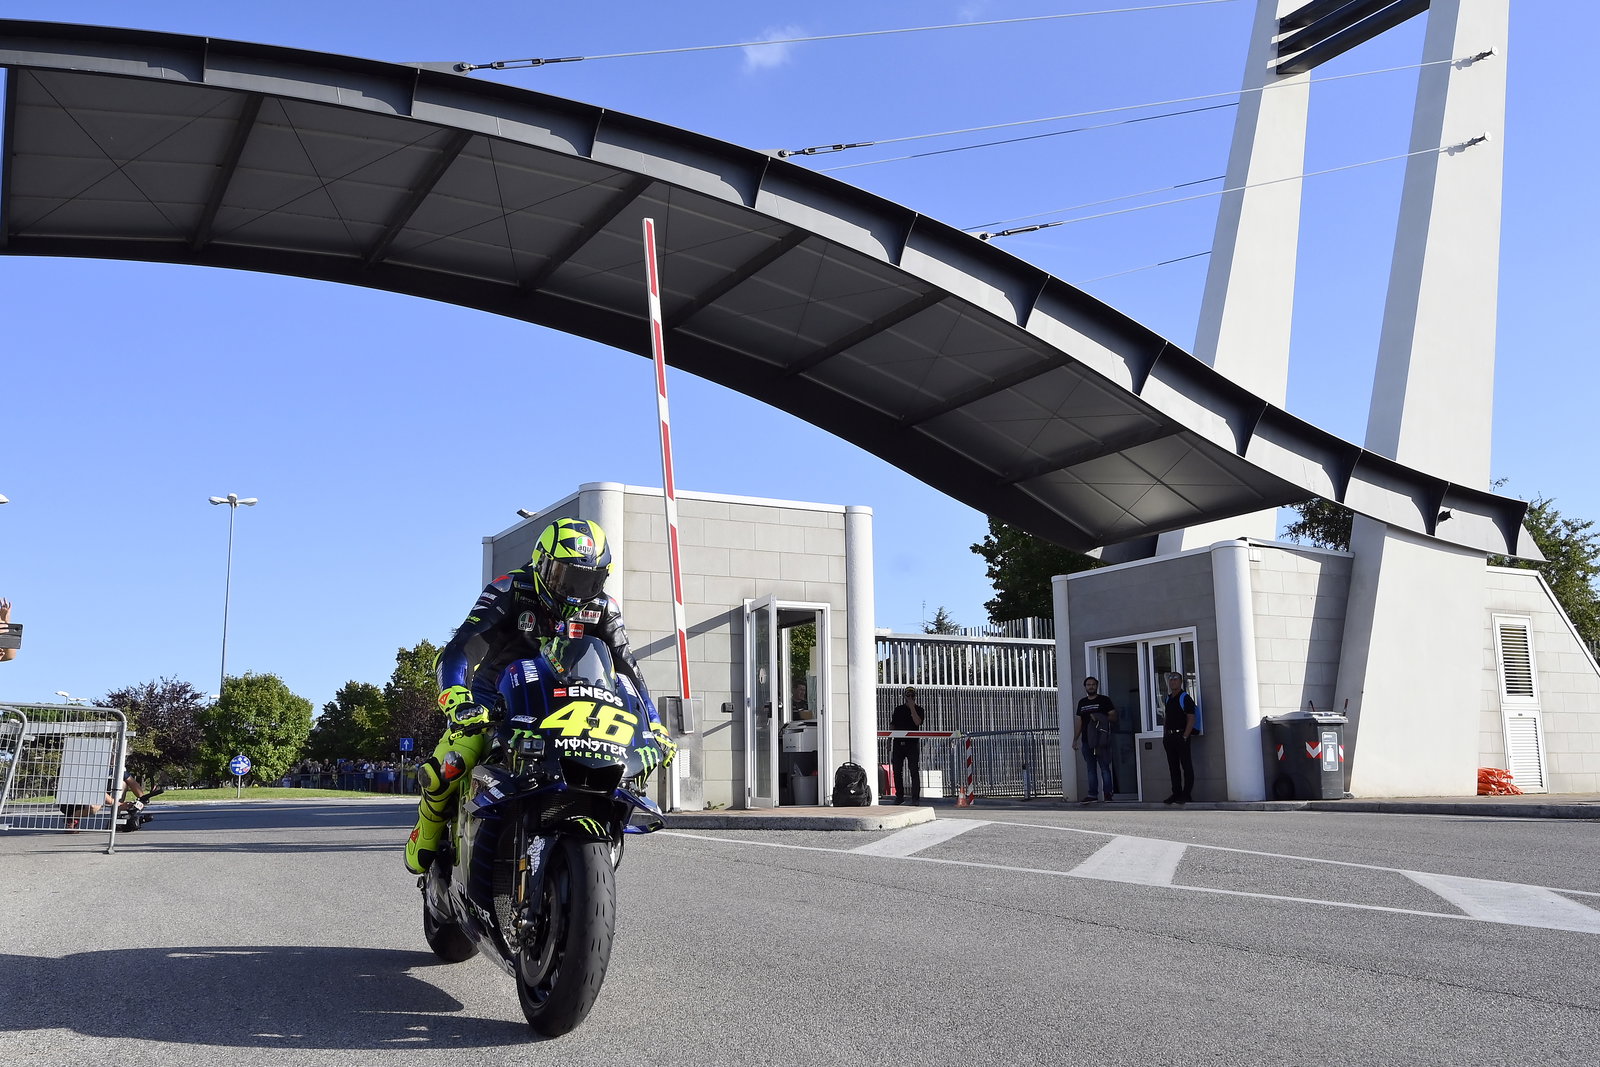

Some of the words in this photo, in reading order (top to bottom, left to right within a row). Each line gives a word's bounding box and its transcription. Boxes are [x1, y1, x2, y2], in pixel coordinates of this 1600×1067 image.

[521, 660, 540, 684] YAMAHA
[568, 686, 624, 707] ENEOS
[539, 701, 638, 745] 46
[554, 737, 628, 759] MONSTER
[565, 750, 620, 763] ENERGY
